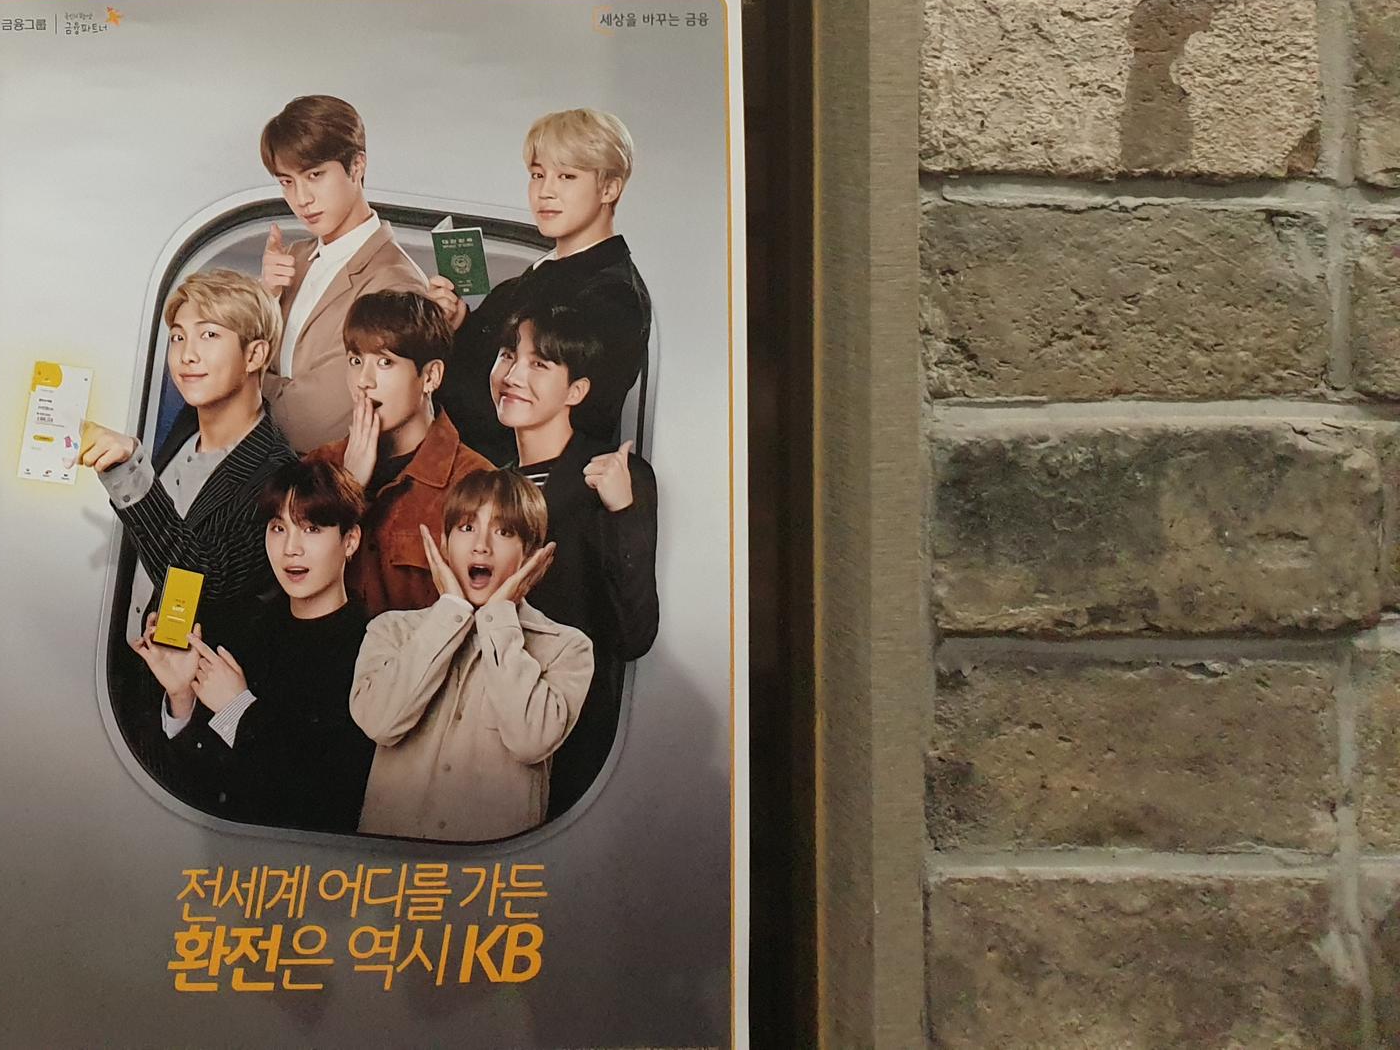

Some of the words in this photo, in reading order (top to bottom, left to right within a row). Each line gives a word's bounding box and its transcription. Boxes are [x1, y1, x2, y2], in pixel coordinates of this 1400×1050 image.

[64, 21, 108, 35] 금융파트너
[600, 12, 637, 27] 세상을
[642, 12, 680, 27] 바꾸는
[685, 12, 709, 27] 금융
[176, 864, 311, 923] 전세계
[318, 862, 452, 922] 어디를
[459, 862, 549, 919] 가든
[167, 924, 335, 992] 환전은
[348, 923, 452, 991] 역시
[458, 922, 544, 984] KB
